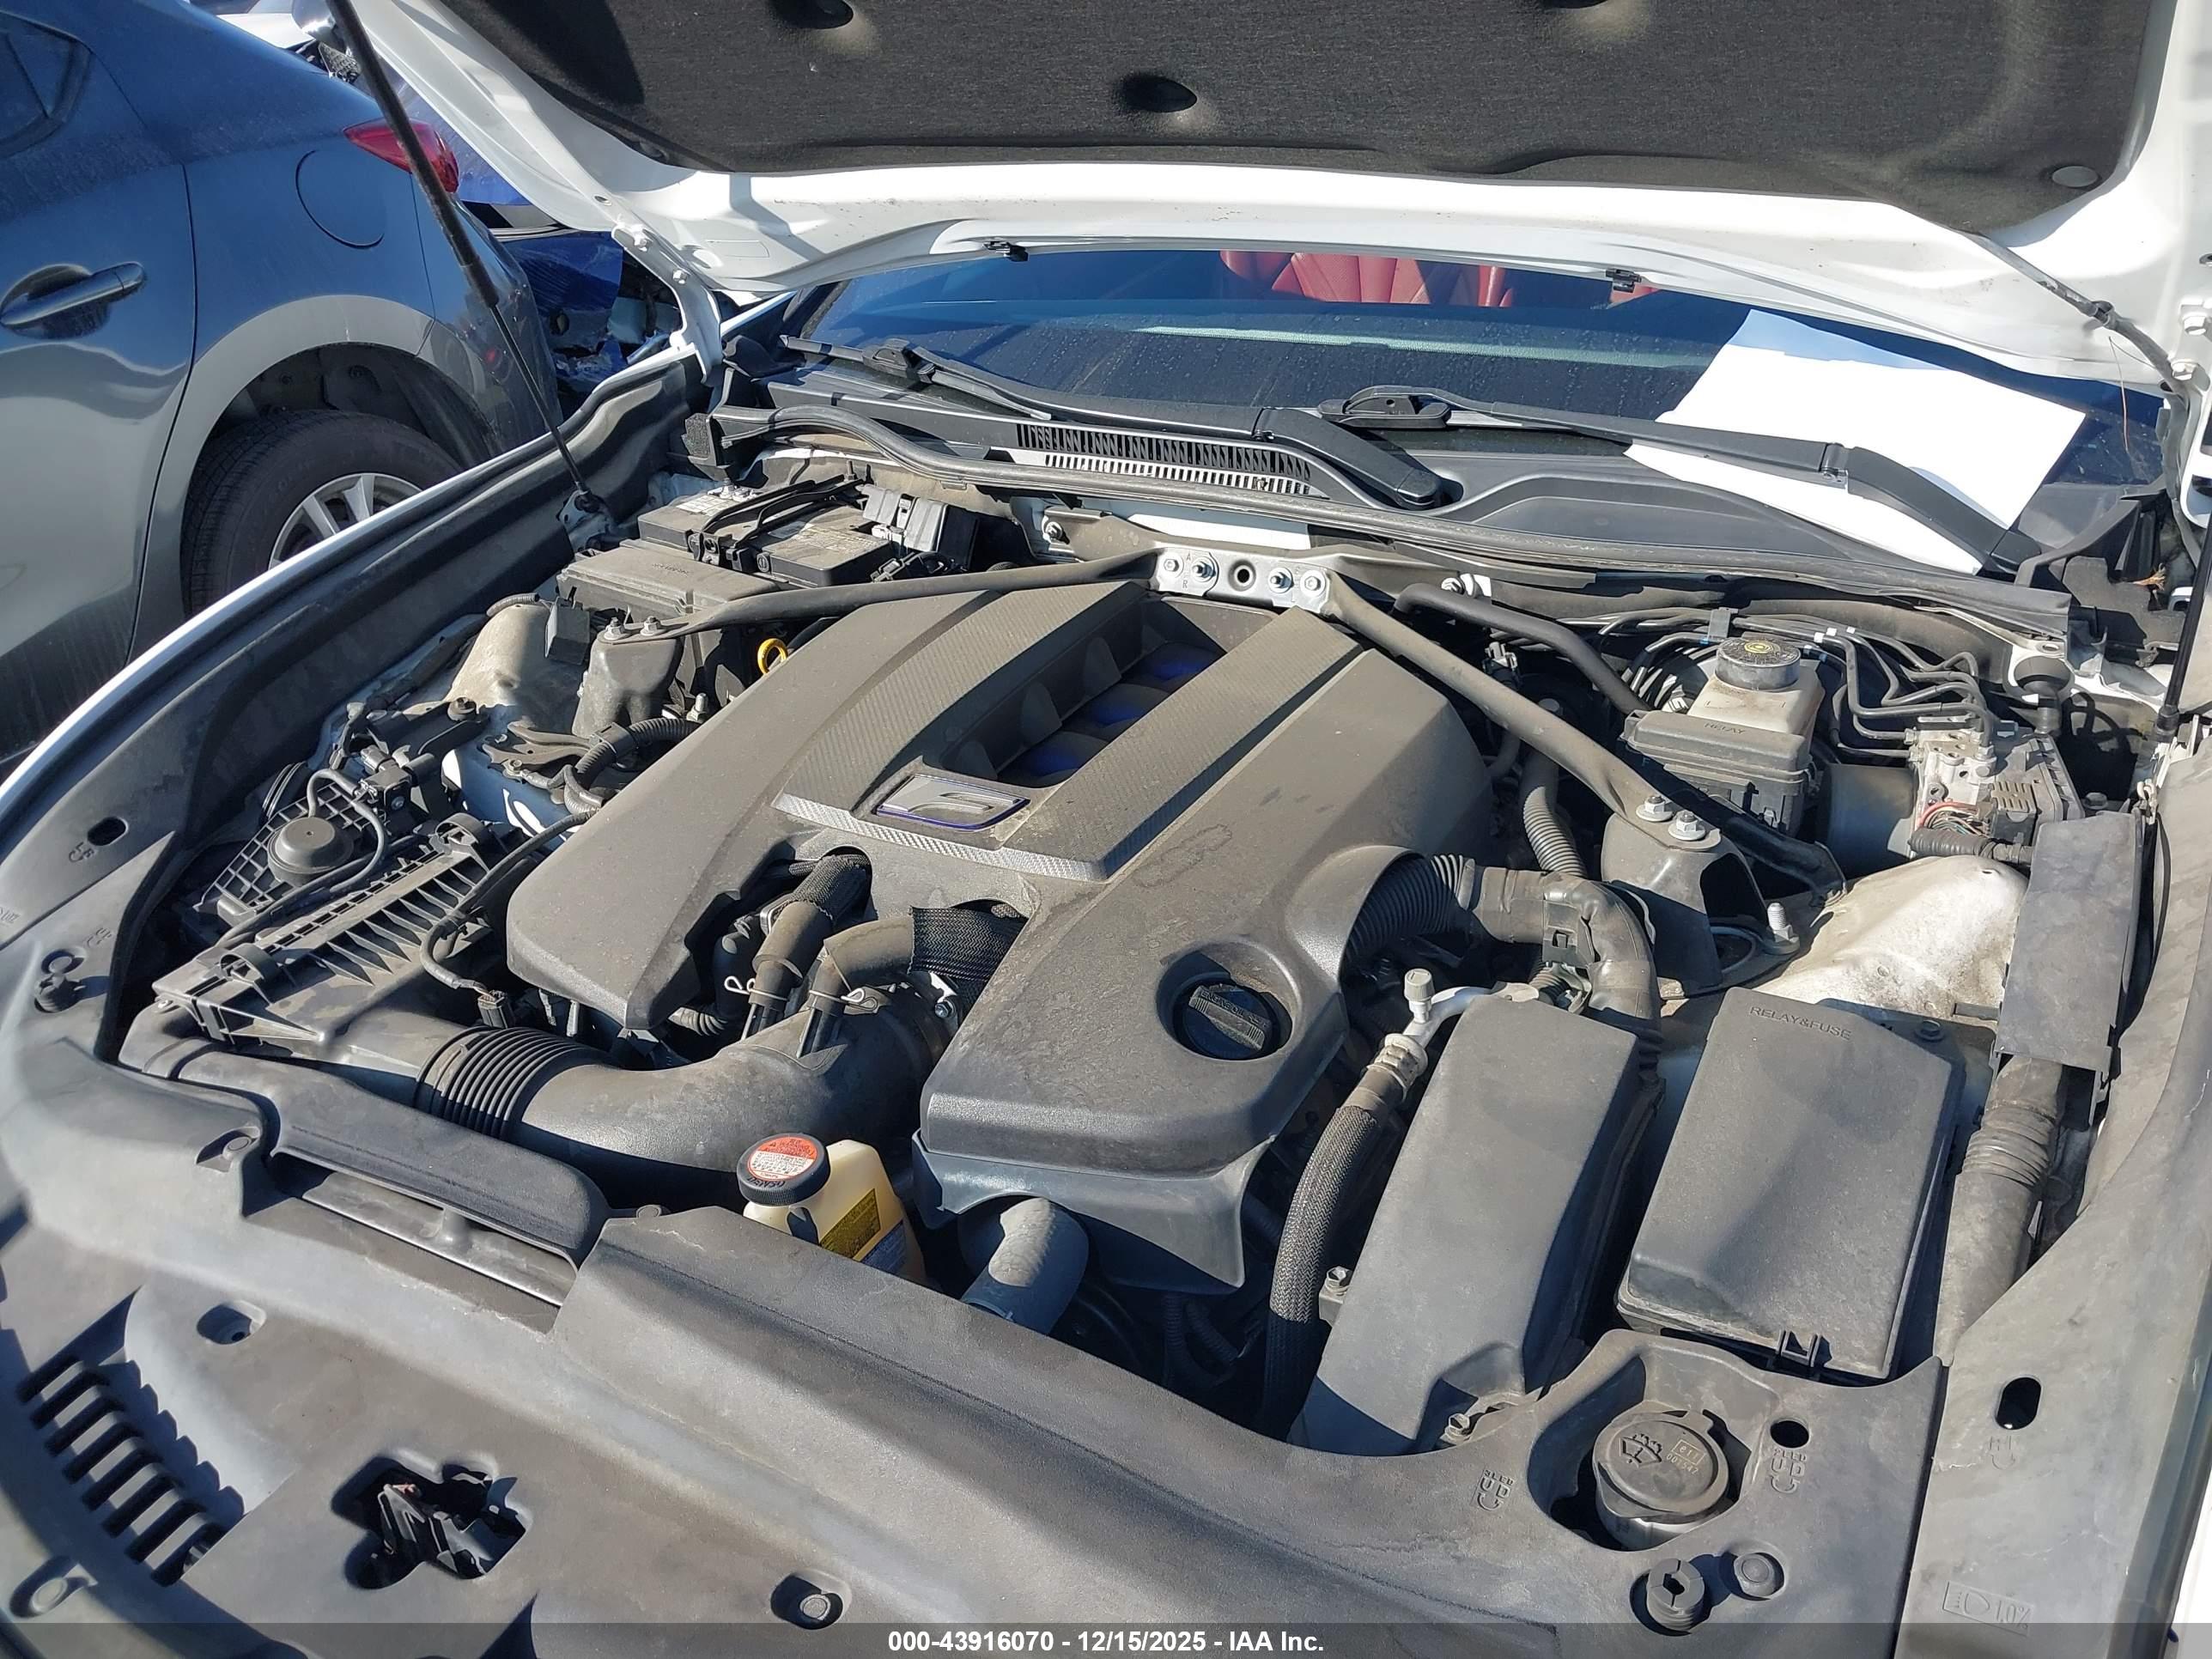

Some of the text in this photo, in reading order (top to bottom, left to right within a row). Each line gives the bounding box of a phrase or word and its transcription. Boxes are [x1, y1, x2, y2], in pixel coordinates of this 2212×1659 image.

[1749, 1006, 1852, 1041] RELAY&FUSE
[746, 1177, 786, 1188] DENSO
[1771, 1457, 1806, 1477] UD
[1480, 1476, 1511, 1499] UD
[1996, 1600, 2032, 1631] 1.0%
